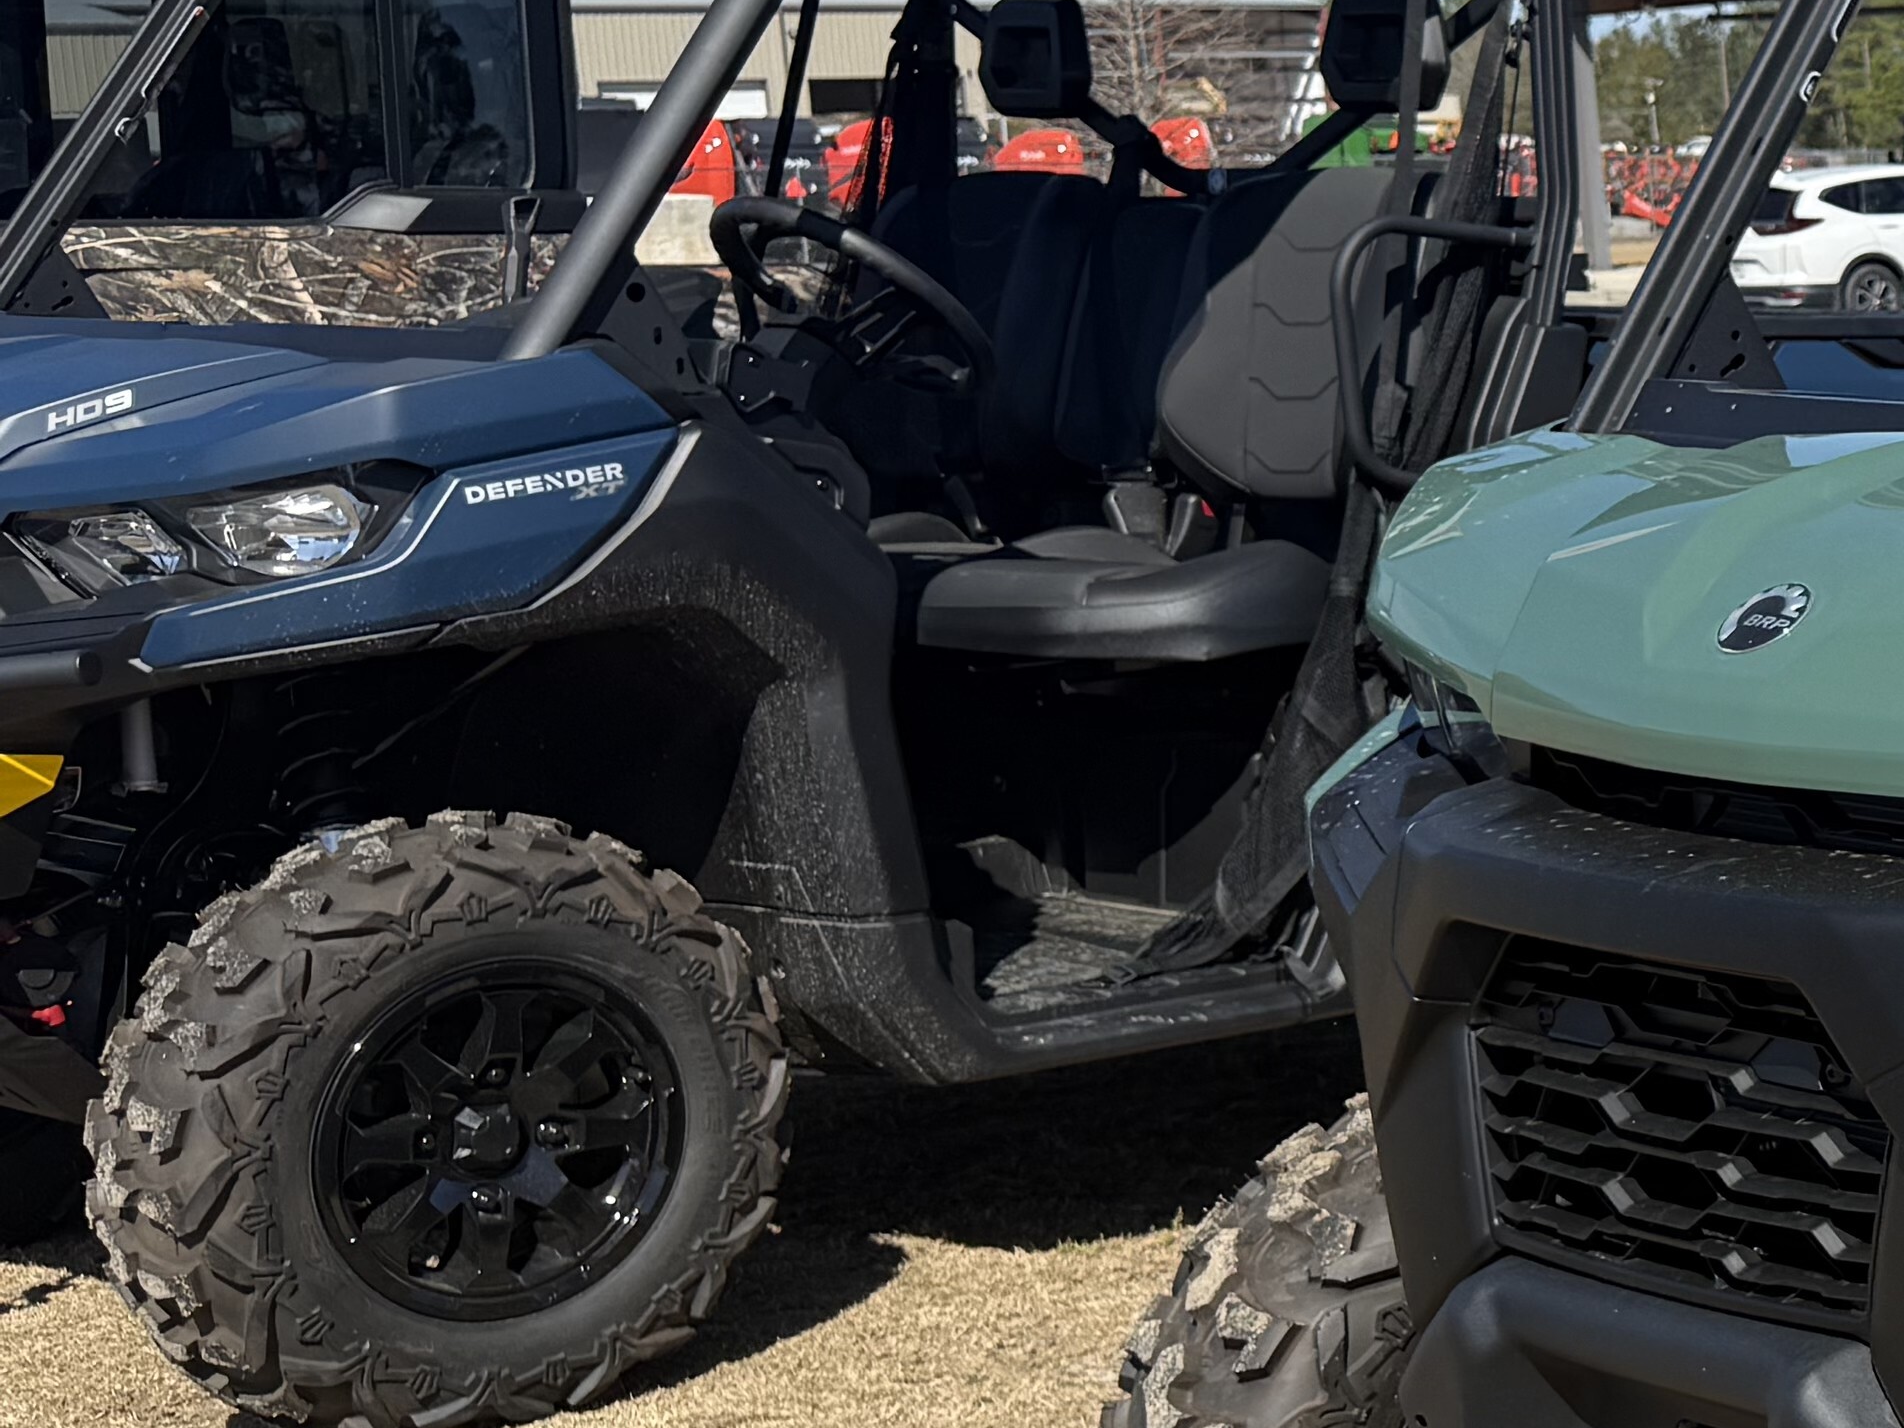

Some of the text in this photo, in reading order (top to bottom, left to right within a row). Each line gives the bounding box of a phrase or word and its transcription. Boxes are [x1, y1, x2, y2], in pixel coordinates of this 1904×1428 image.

[47, 388, 133, 432] HD9
[464, 462, 625, 505] DEFENDER
[570, 479, 625, 502] XT
[1742, 610, 1793, 632] BRP
